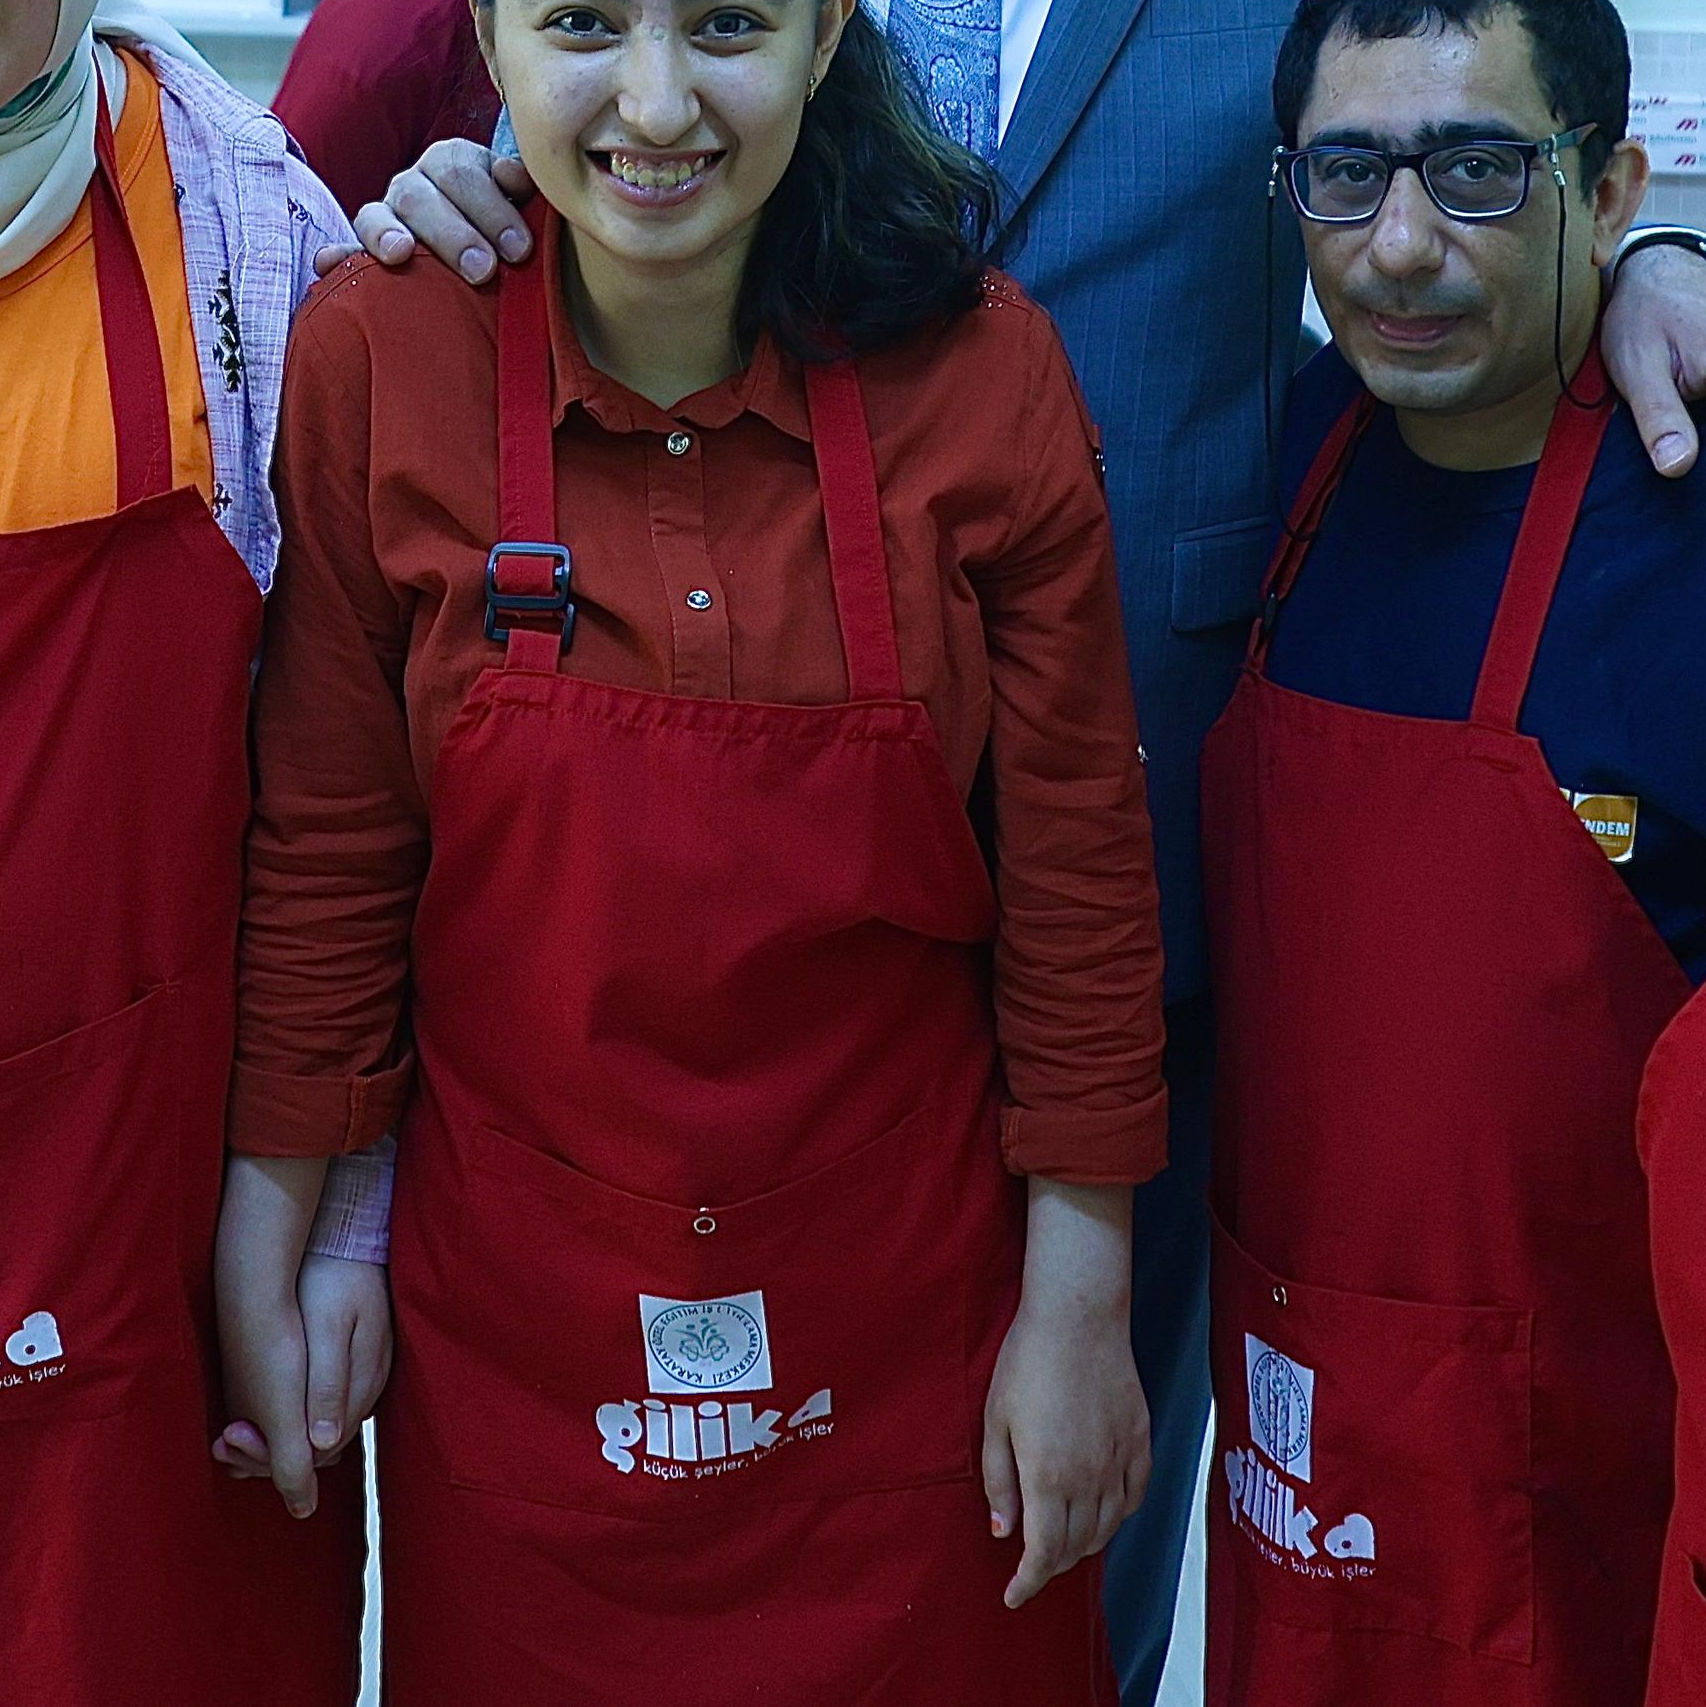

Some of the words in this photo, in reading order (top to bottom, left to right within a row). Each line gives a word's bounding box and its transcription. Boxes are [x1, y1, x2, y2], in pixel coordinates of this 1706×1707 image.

[1580, 818, 1630, 836] NDEM
[29, 1363, 67, 1382] işler
[643, 1459, 689, 1481] küçük
[1291, 1557, 1335, 1580] büyük
[1341, 1563, 1377, 1582] işler
